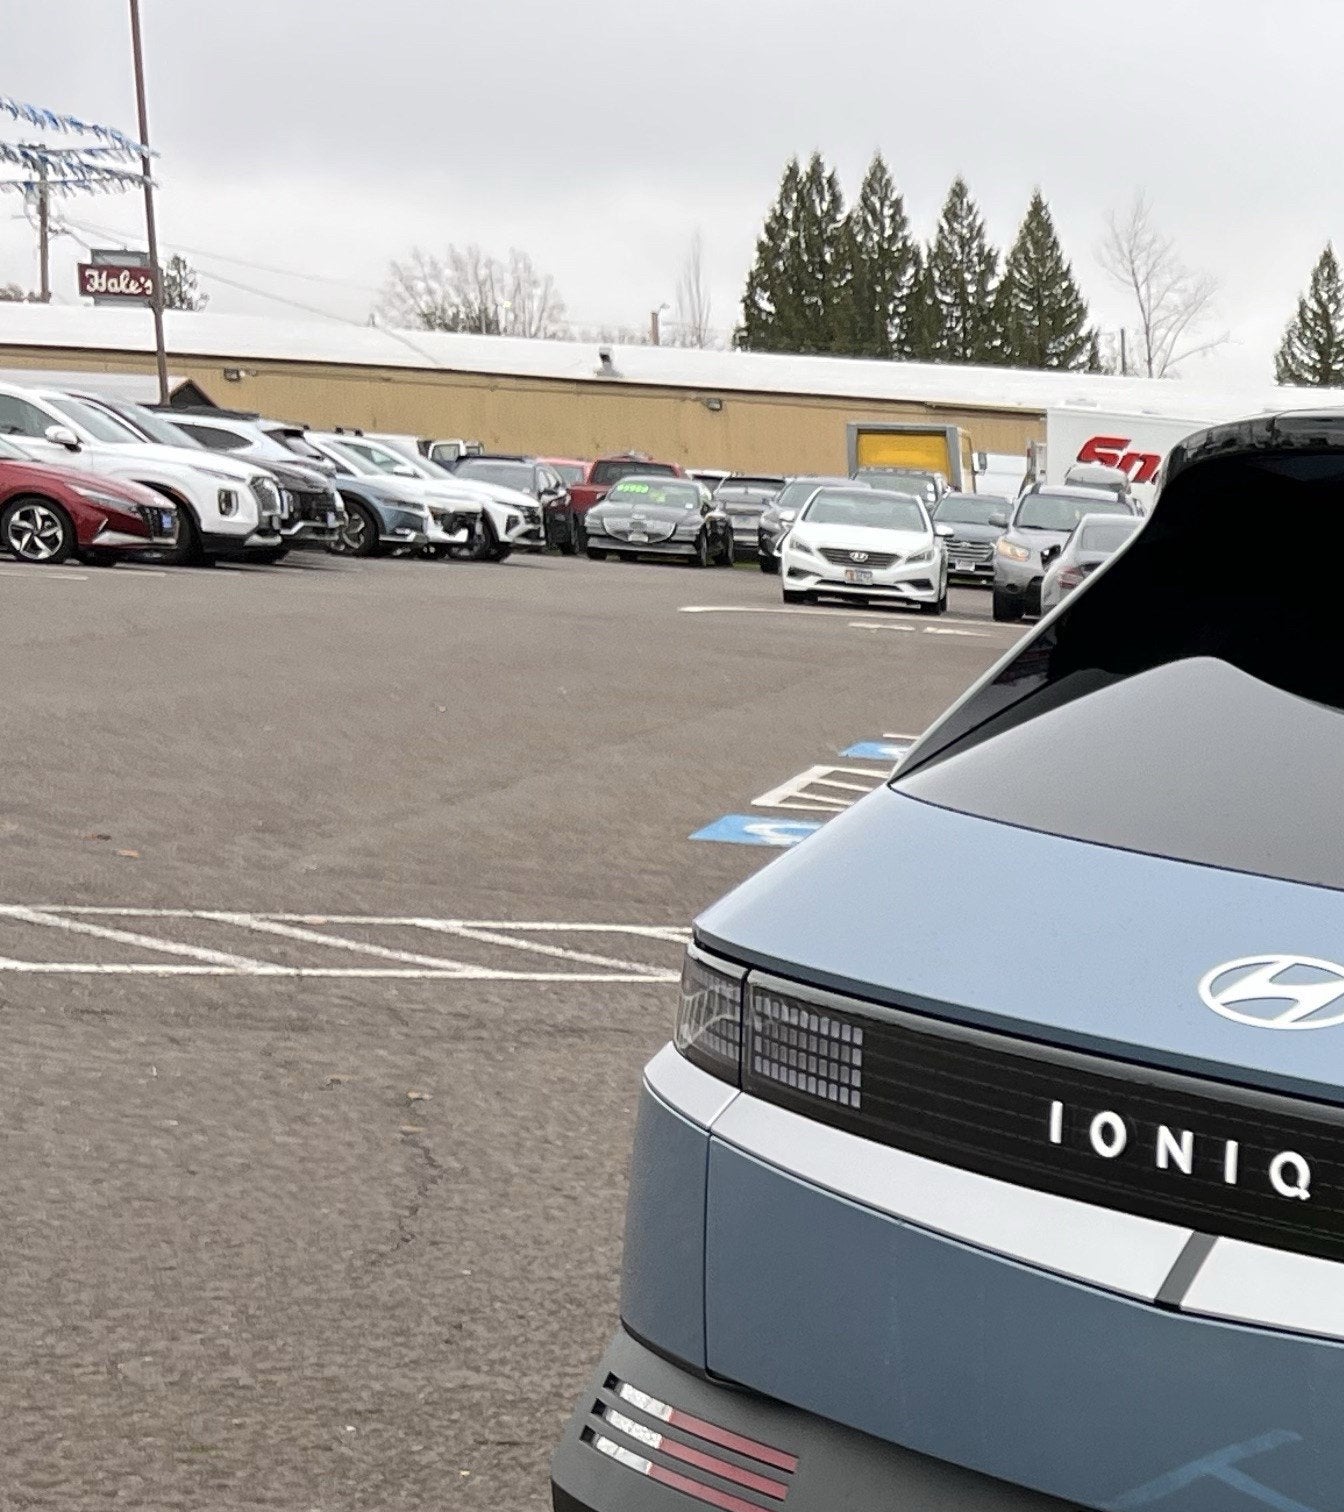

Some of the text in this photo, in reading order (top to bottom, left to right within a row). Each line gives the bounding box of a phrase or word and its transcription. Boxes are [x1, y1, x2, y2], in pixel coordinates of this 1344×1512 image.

[84, 268, 153, 295] Hale's
[1077, 436, 1167, 484] Sn
[1050, 1100, 1311, 1201] IONIQ
